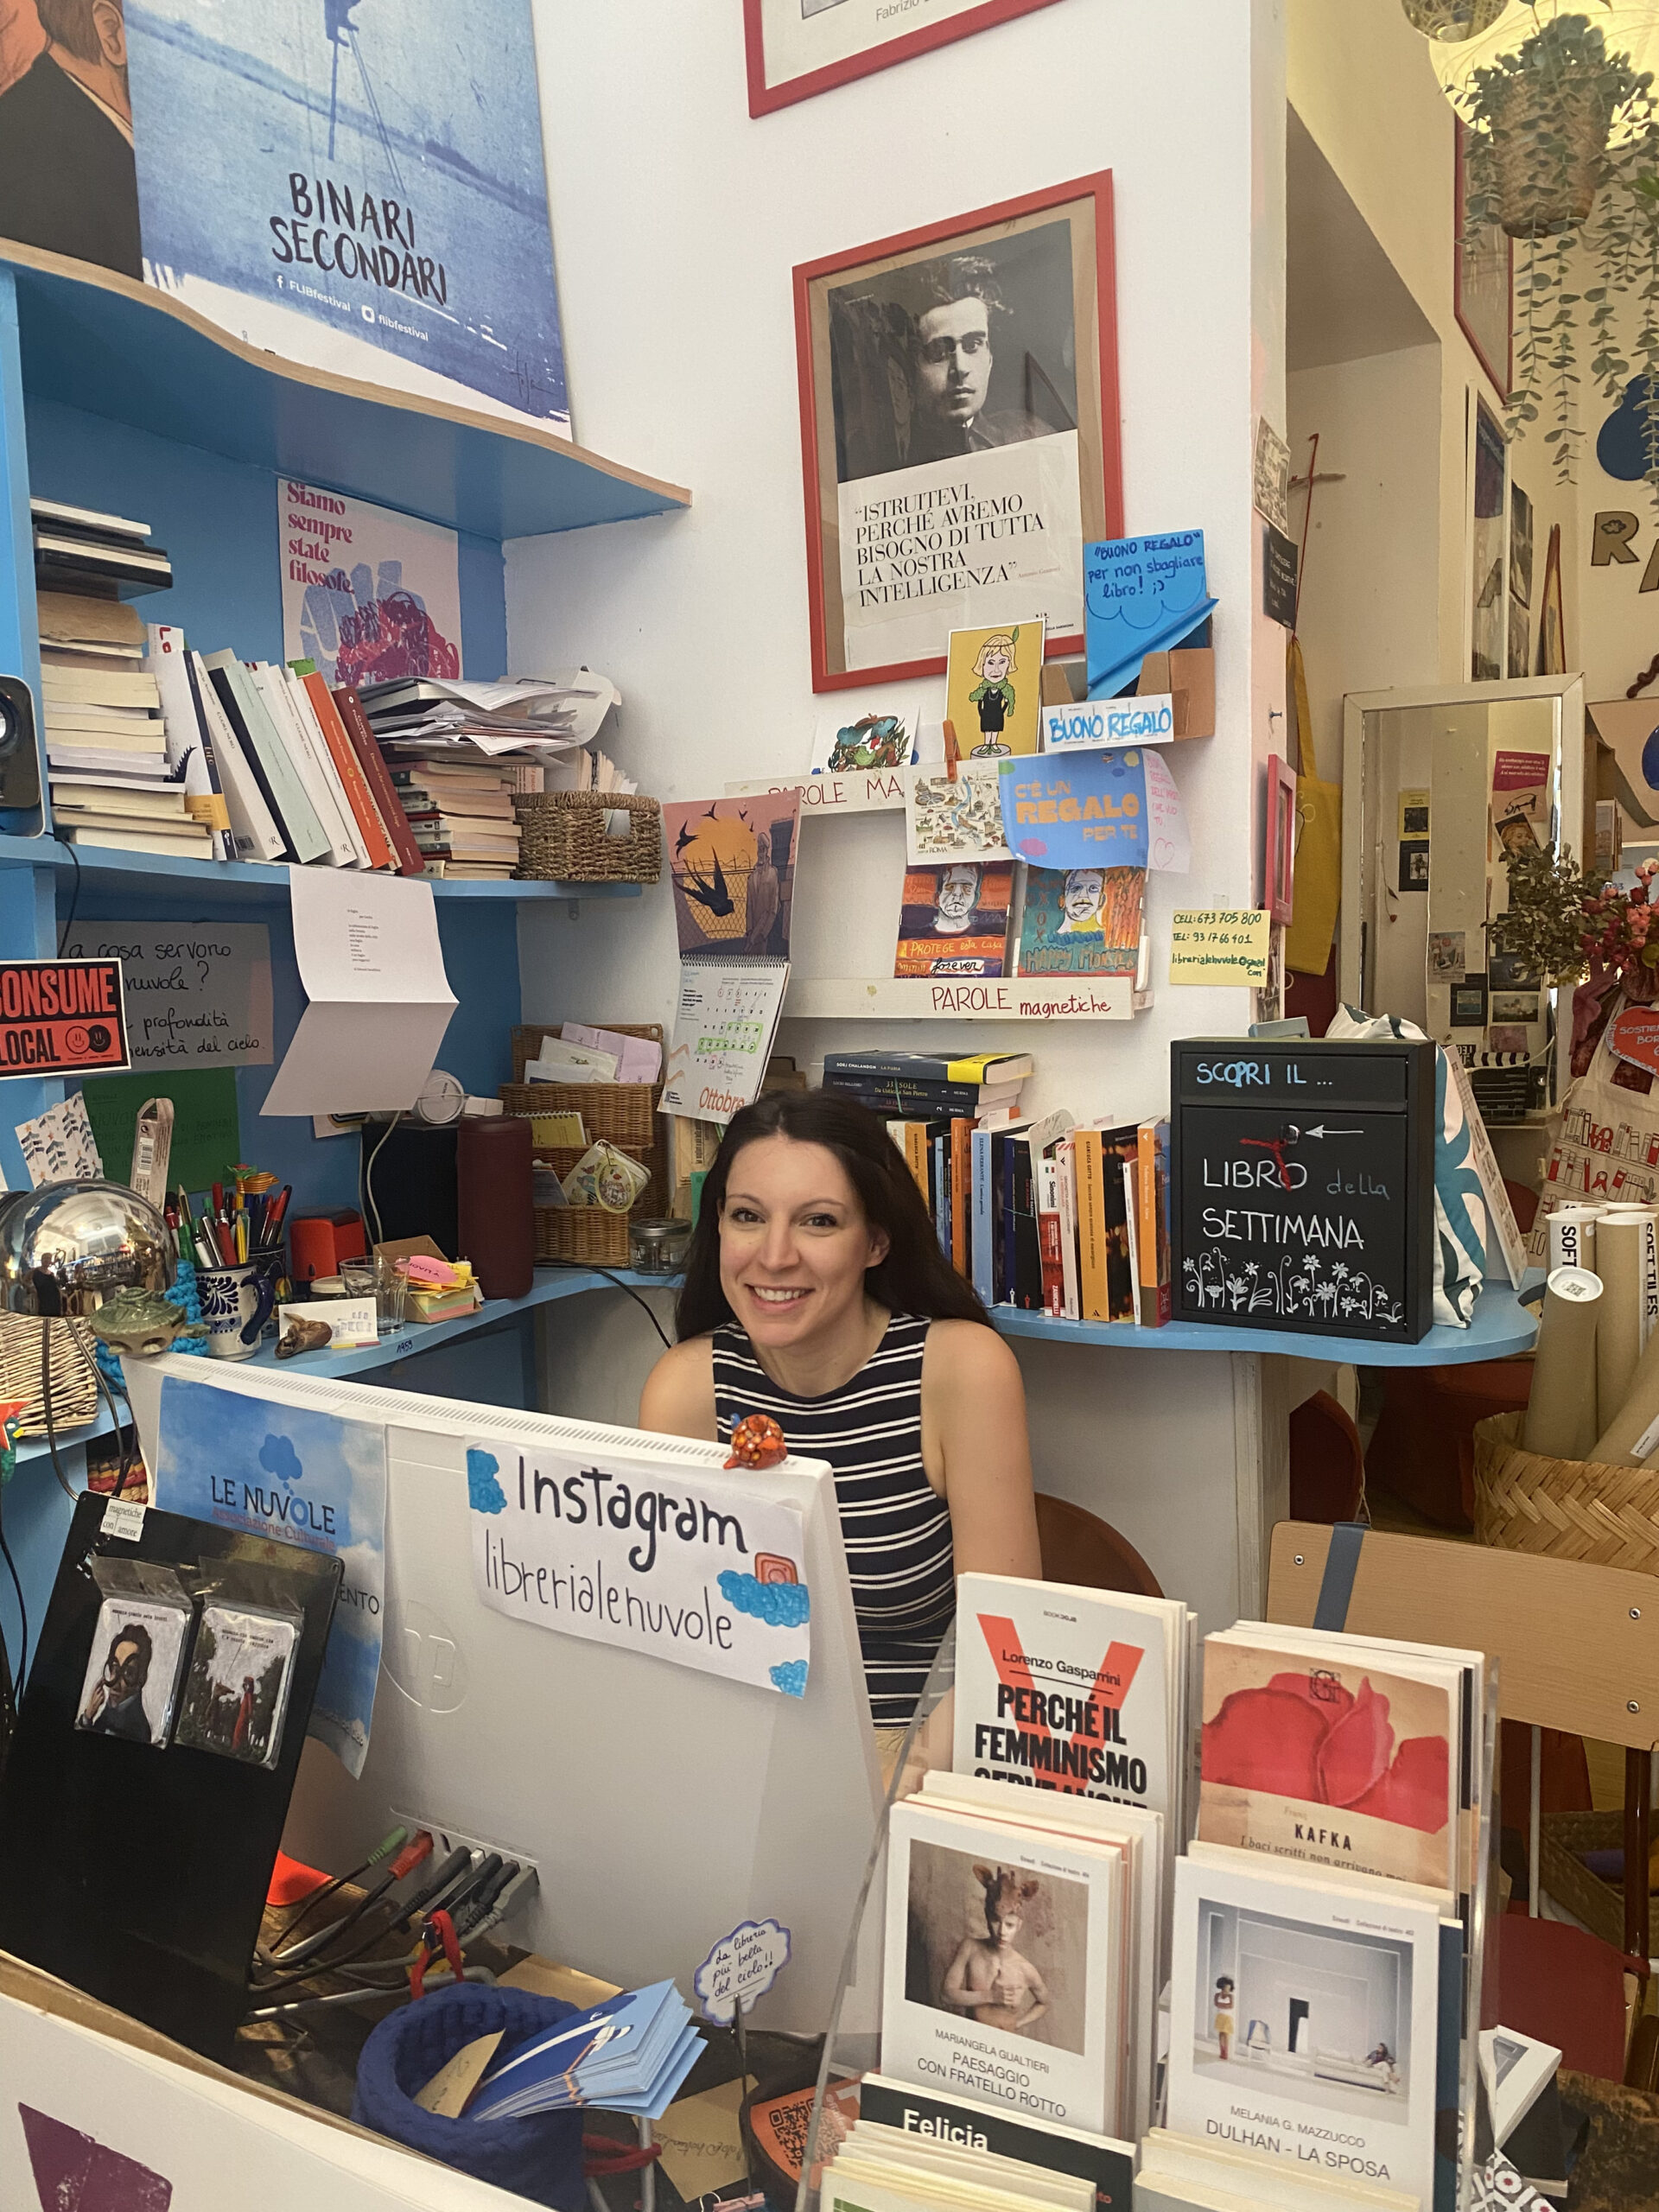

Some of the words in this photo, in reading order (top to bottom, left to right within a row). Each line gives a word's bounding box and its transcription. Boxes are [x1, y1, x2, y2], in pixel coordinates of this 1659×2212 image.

[289, 173, 415, 251] BINARI
[269, 216, 447, 306] SECONDARI
[289, 280, 351, 312] FLIBfestival
[378, 315, 429, 341] flibfestival
[287, 480, 346, 516] Siamo
[288, 513, 353, 543] sempre
[856, 509, 934, 544] PERCHÉ
[941, 493, 1023, 528] AVREMO
[289, 537, 330, 563] state
[857, 532, 943, 565] BISOGNO
[950, 525, 969, 547] DI
[975, 512, 1045, 542] TUTTA
[289, 559, 355, 594] filosofe.
[858, 566, 883, 586] LA
[891, 550, 967, 581] NOSTRA
[1088, 568, 1109, 584] per
[1115, 563, 1141, 577] non
[1147, 556, 1204, 579] sbagliare
[1103, 575, 1143, 598] libro!
[1049, 715, 1103, 743] BUONO
[1108, 708, 1173, 737] REGALO
[769, 782, 848, 805] ROLE
[1047, 779, 1071, 796] UN
[1015, 793, 1140, 824] REGALO
[1083, 826, 1116, 842] PER
[1121, 824, 1138, 839] TE
[1197, 912, 1217, 925] 673
[1219, 912, 1239, 925] 705
[1241, 912, 1262, 925] 800
[98, 943, 143, 960] cosa
[155, 941, 232, 959] servono
[1192, 932, 1205, 942] 93
[0, 967, 118, 1019] ONSUME
[124, 966, 190, 991] nuvole
[931, 986, 1013, 1012] PAROLE
[1020, 995, 1111, 1019] magnetiche
[143, 1007, 230, 1040] profondità
[0, 1026, 61, 1066] OCAL
[197, 1036, 221, 1053] del
[1197, 1061, 1270, 1088] SCOPRI
[1287, 1064, 1306, 1084] IL
[699, 1086, 746, 1113] Ottobre
[1204, 1158, 1308, 1192] LIBRO
[1326, 1168, 1391, 1201] della
[1203, 1207, 1365, 1250] SETTIMANA
[1561, 1225, 1577, 1268] SOFT
[109, 1504, 142, 1519] magnetiche
[211, 1475, 236, 1506] LE
[244, 1483, 335, 1535] NUVOLE
[519, 1456, 749, 1573] Instagram
[103, 1520, 114, 1529] con
[118, 1525, 137, 1536] amore
[212, 1507, 282, 1535] Associazione
[284, 1525, 336, 1550] Culturale
[486, 1528, 733, 1649] librerialenuvole
[1002, 1649, 1053, 1669] Lorenzo
[1057, 1661, 1121, 1687] Gasparrini
[998, 1683, 1100, 1738] PERCHÉ
[1103, 1706, 1128, 1745] IL
[975, 1724, 1147, 1795] FEMMINISMO
[1249, 1836, 1271, 1852] baci
[1274, 1844, 1306, 1859] scritti
[1310, 1853, 1331, 1865] non
[1294, 1823, 1353, 1852] KAFKA
[734, 1929, 766, 1950] libreria
[739, 1945, 764, 1967] bella
[715, 1977, 731, 1997] del
[935, 2029, 996, 2056] MARIANGELA
[999, 2049, 1051, 2075] GUALTIERI
[953, 2051, 1031, 2088] PAESAGGIO
[918, 2057, 947, 2077] CON
[950, 2069, 1016, 2101] FRATELLO
[1020, 2092, 1067, 2118] ROTTO
[903, 2108, 989, 2152] Felicia
[1230, 2105, 1281, 2128] MELANIA
[1283, 2120, 1294, 2131] G.
[1298, 2123, 1365, 2149] MAZZUCCO
[1206, 2119, 1281, 2153] DULHAN
[1298, 2144, 1321, 2164] LA
[1325, 2151, 1391, 2181] SPOSA
[1096, 2191, 1112, 2203] to
